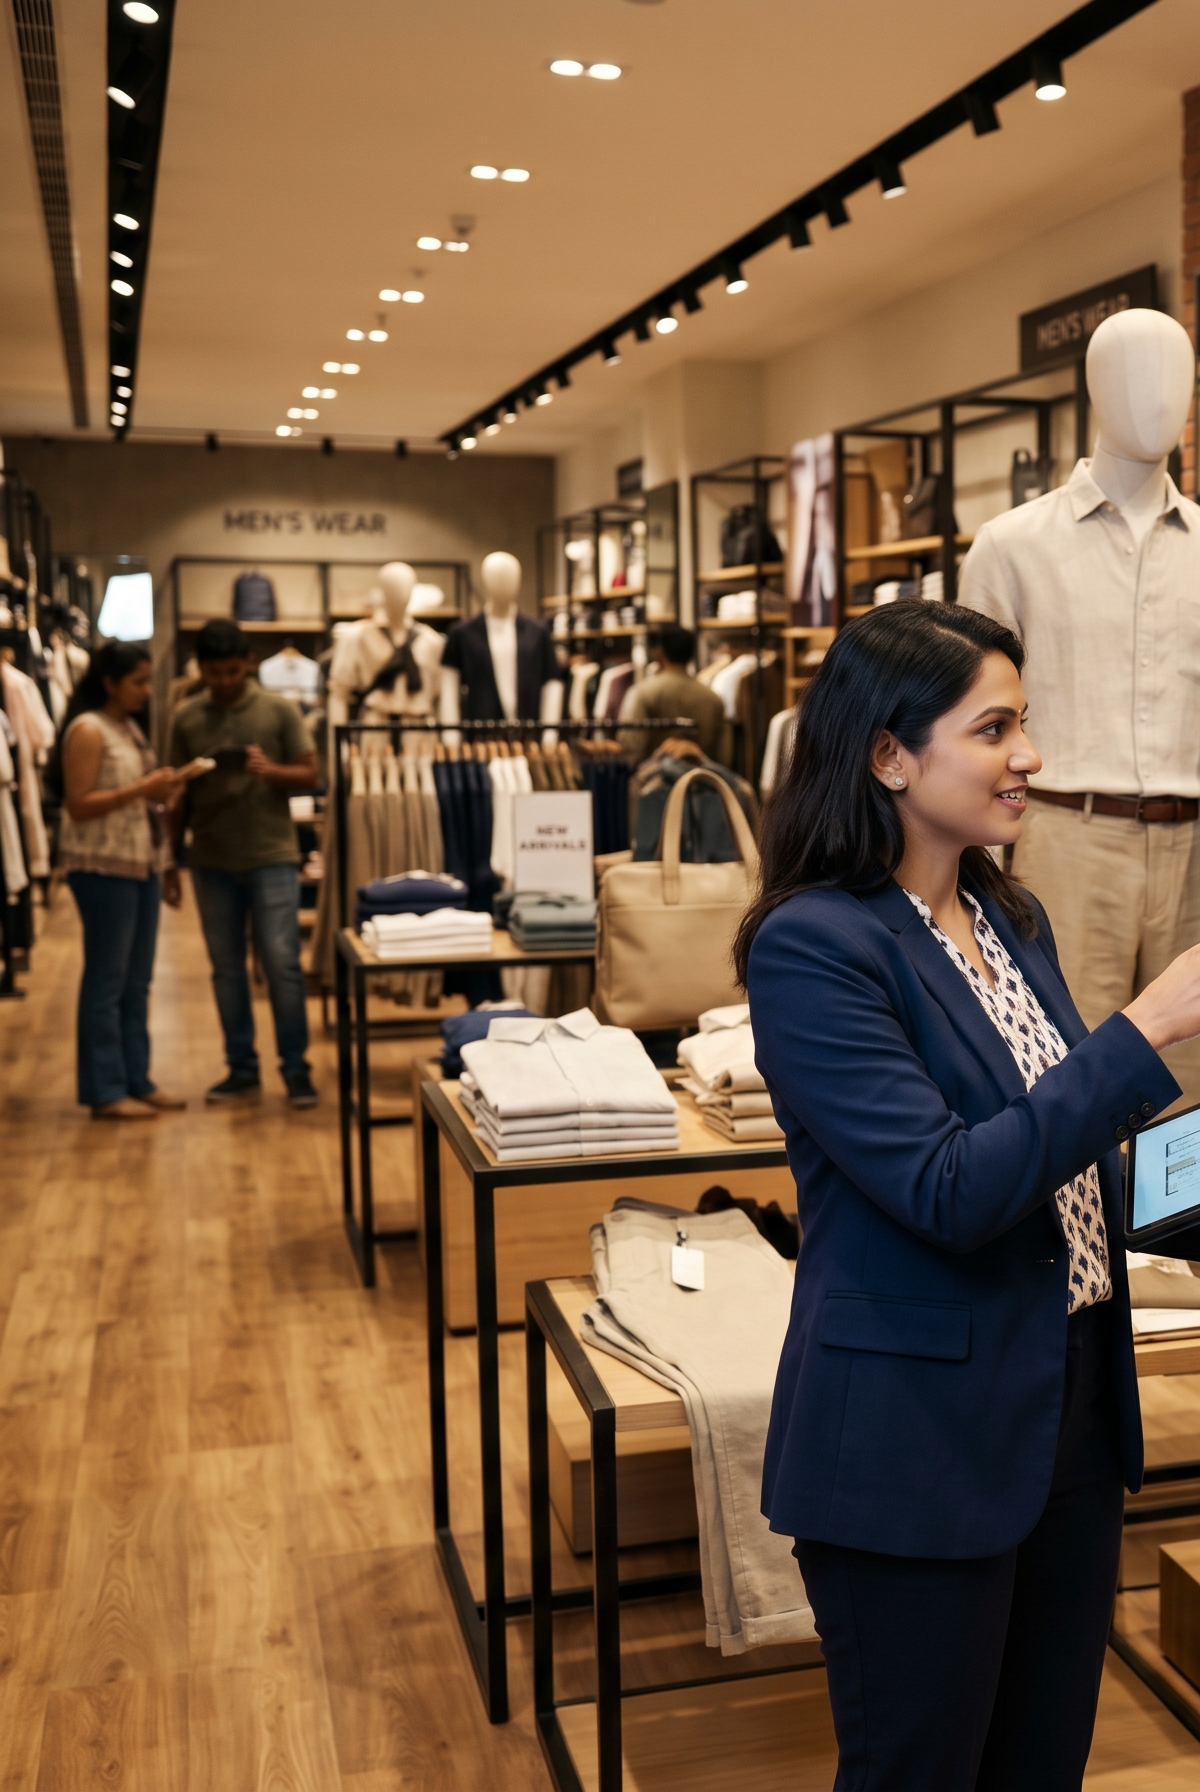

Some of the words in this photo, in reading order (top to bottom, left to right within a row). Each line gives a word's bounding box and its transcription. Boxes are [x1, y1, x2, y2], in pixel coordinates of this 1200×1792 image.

[1037, 310, 1081, 351] MEN'S
[224, 510, 302, 534] MEN'S
[310, 511, 387, 535] WEAR
[536, 824, 568, 836] NEW
[520, 841, 585, 851] ARRIVALS
